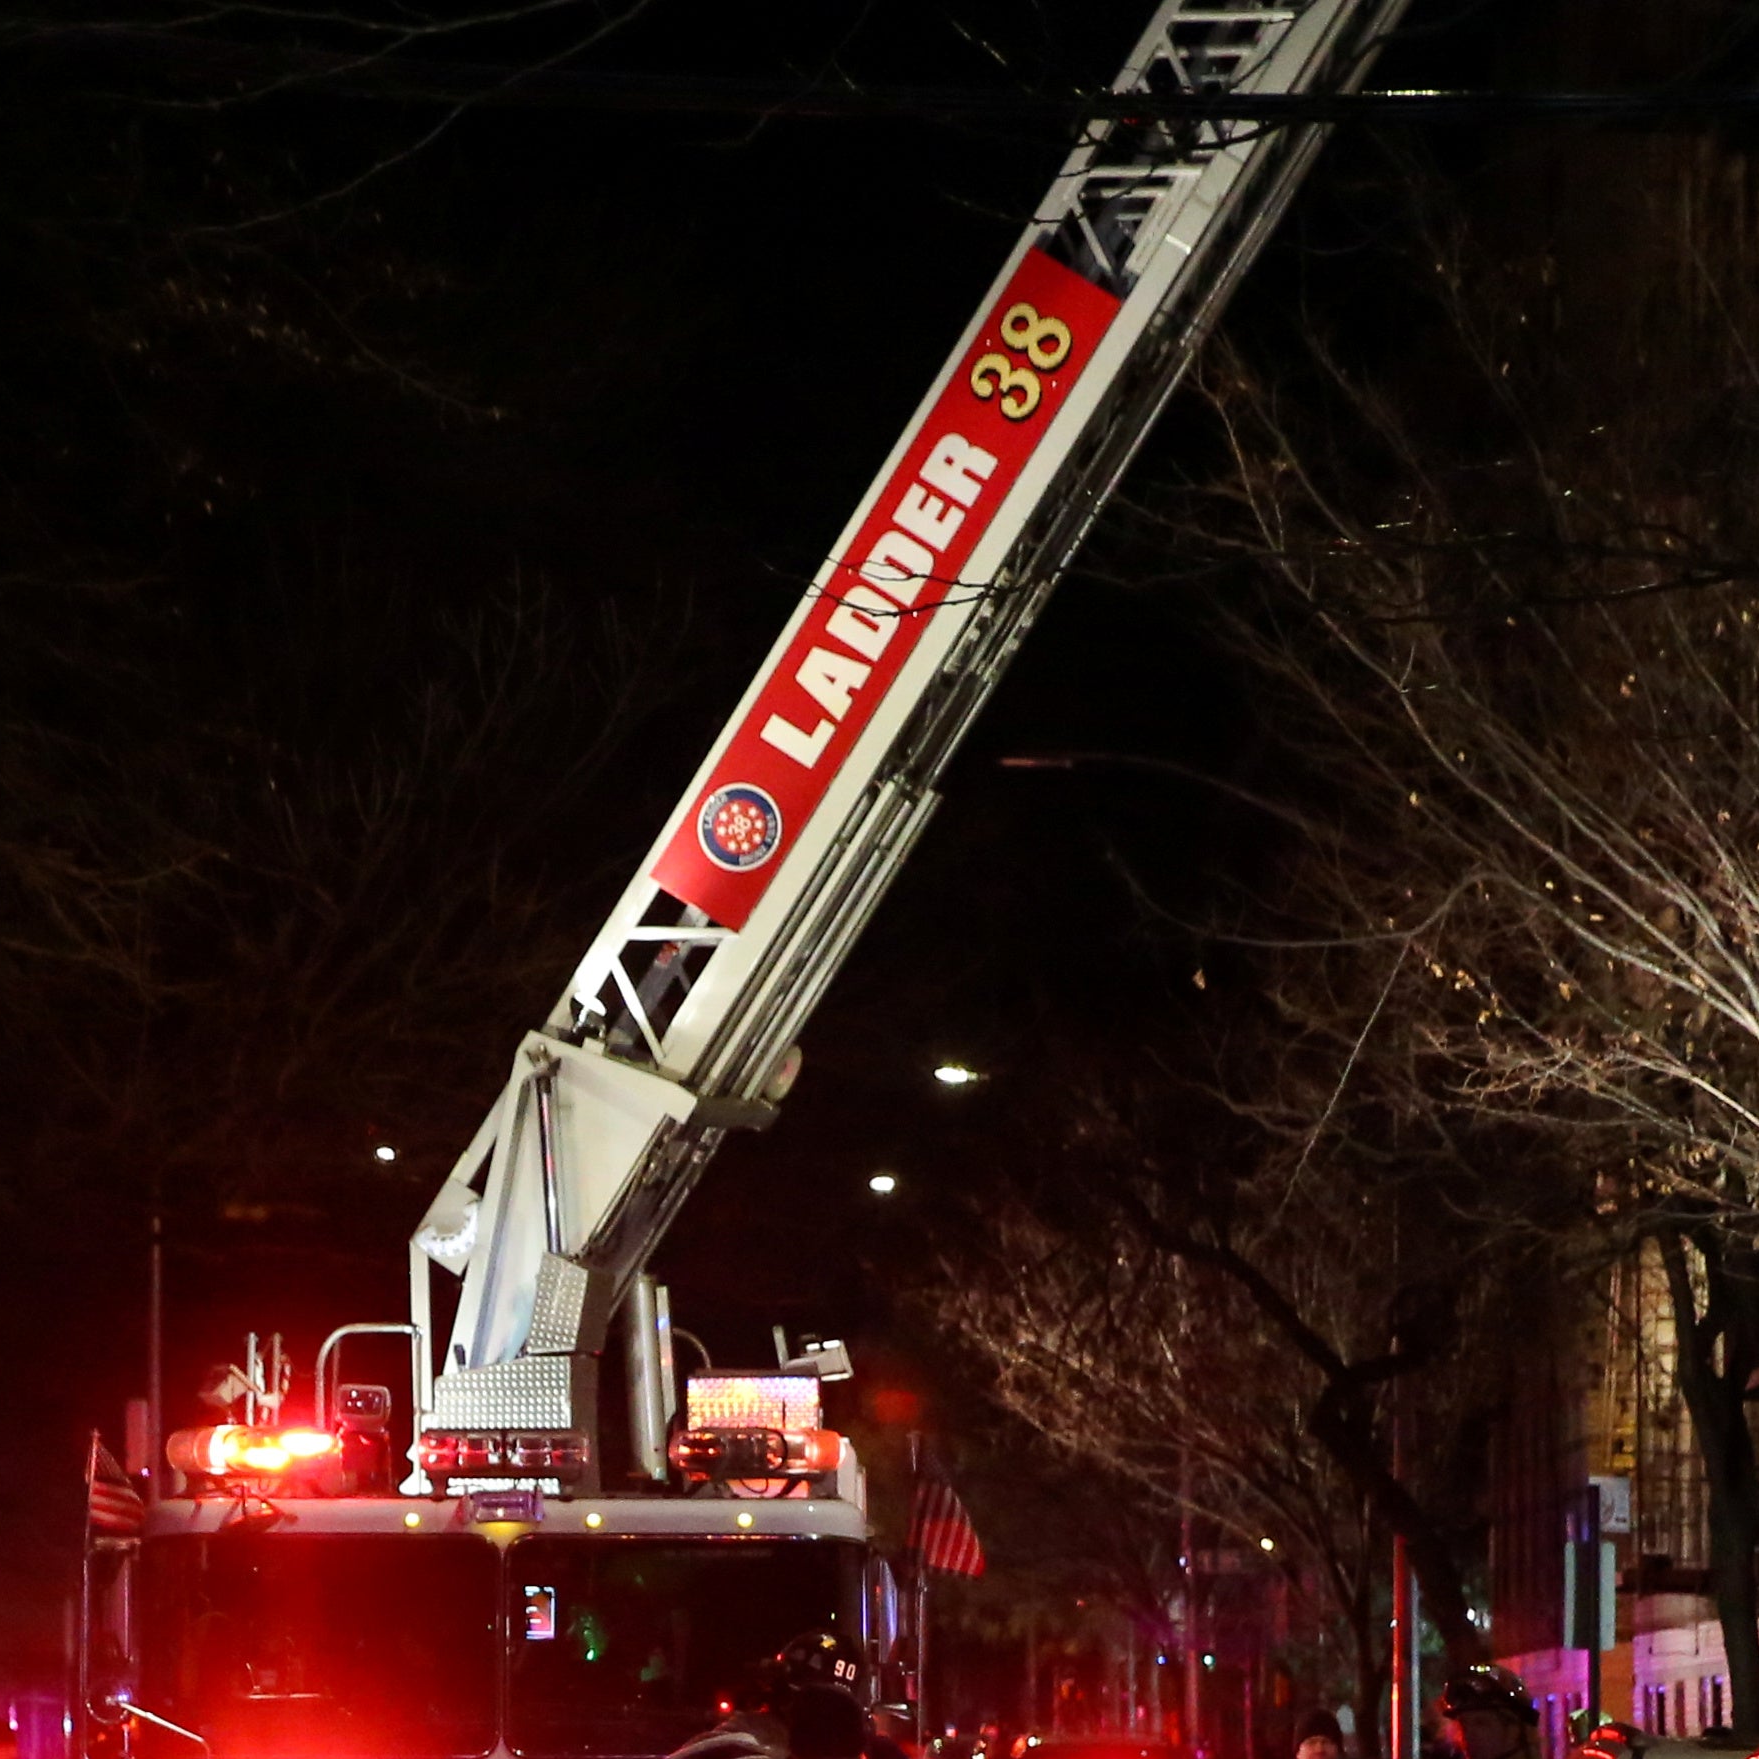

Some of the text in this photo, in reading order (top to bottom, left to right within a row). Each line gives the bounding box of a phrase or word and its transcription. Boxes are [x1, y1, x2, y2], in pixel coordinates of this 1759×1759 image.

[760, 302, 1073, 770] LADDER 38
[834, 1659, 856, 1681] 90
